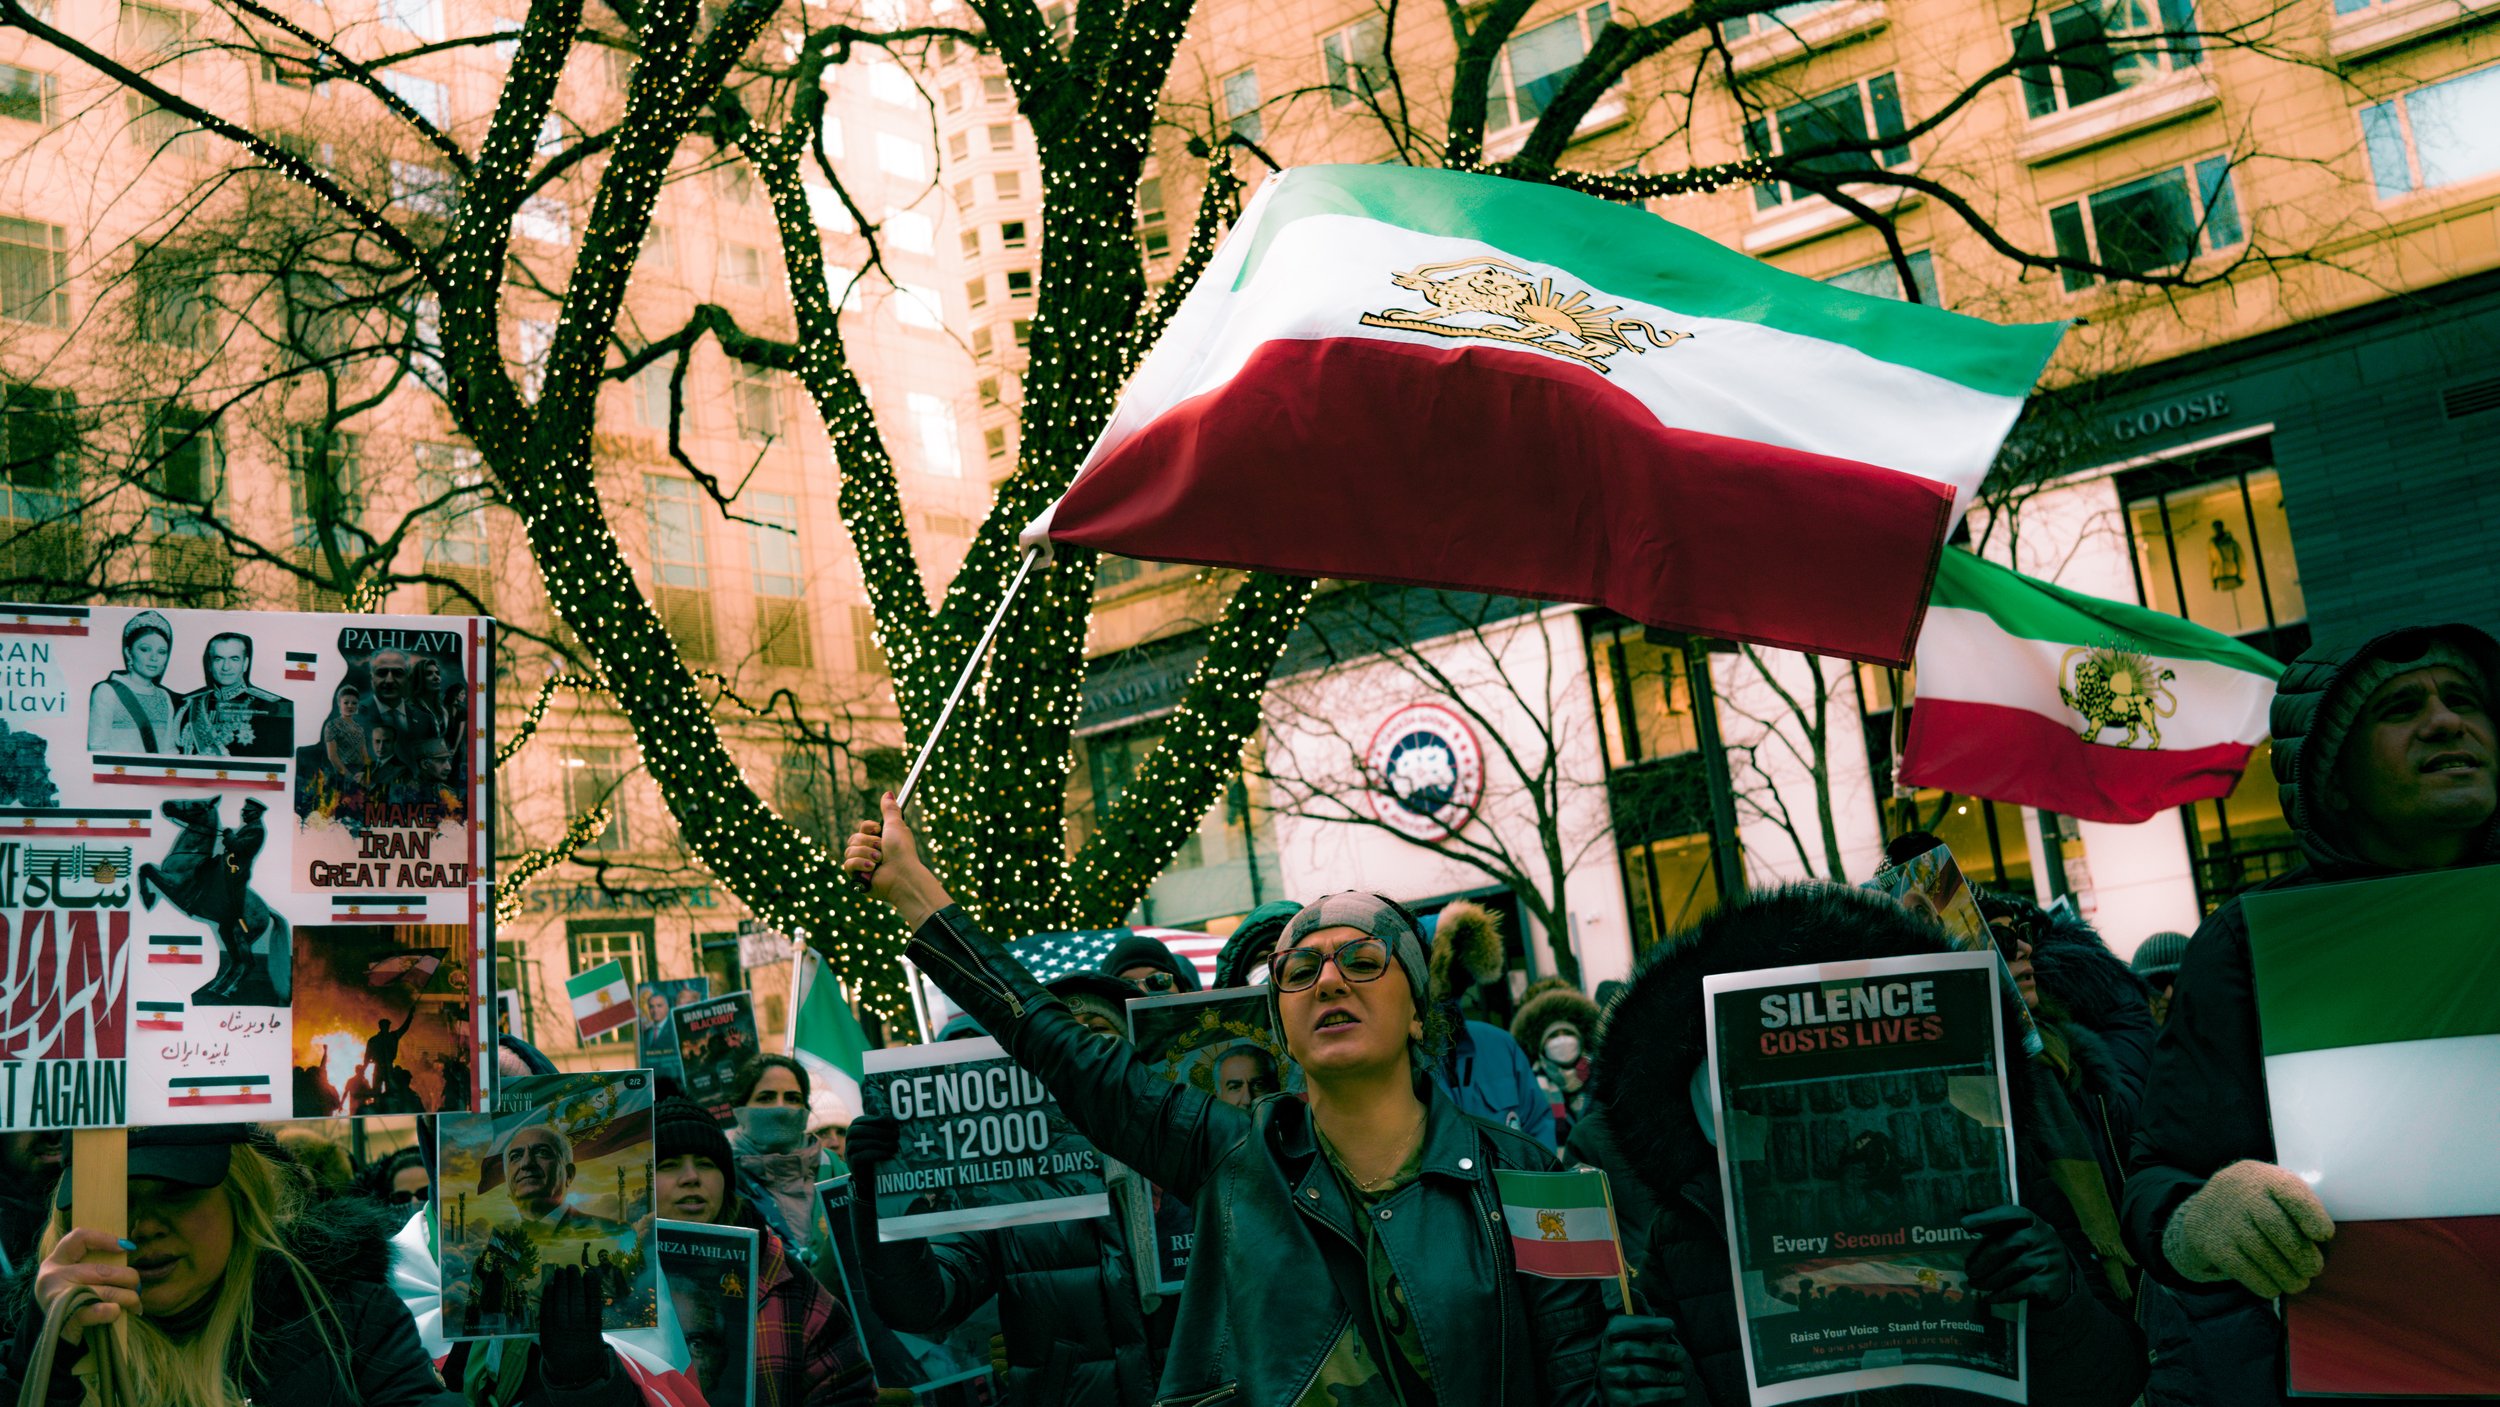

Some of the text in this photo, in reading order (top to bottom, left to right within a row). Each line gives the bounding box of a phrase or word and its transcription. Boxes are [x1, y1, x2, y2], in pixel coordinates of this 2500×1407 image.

[2113, 391, 2231, 441] GOOSE
[0, 642, 49, 663] AN
[344, 628, 458, 653] PAHLAVI
[0, 666, 46, 687] ith
[0, 690, 66, 712] lavi
[363, 801, 439, 828] MAKE
[358, 831, 431, 859] IRAN
[309, 860, 391, 887] GREAT
[688, 884, 719, 909] XL
[682, 1009, 704, 1024] IRAN
[711, 1002, 739, 1017] TOTAL
[1759, 980, 1937, 1029] SILENCE
[219, 1010, 244, 1032] شاه
[690, 1012, 735, 1032] BLACKOUT
[1760, 1016, 1943, 1056] COSTS LIVES
[30, 1060, 127, 1127] AGAIN
[629, 1078, 641, 1086] 2/2
[889, 1066, 1057, 1120] GENOCID
[914, 1110, 1049, 1162] +12000
[877, 1150, 1099, 1194] INNOCENT KILLED IN 2 DAYS.
[657, 1240, 747, 1262] REZA PAHLAVI
[1772, 1232, 1828, 1255] Every
[1834, 1228, 1906, 1250] Second
[1790, 1318, 1985, 1344] Raise Your Voice Stand for Freedom
